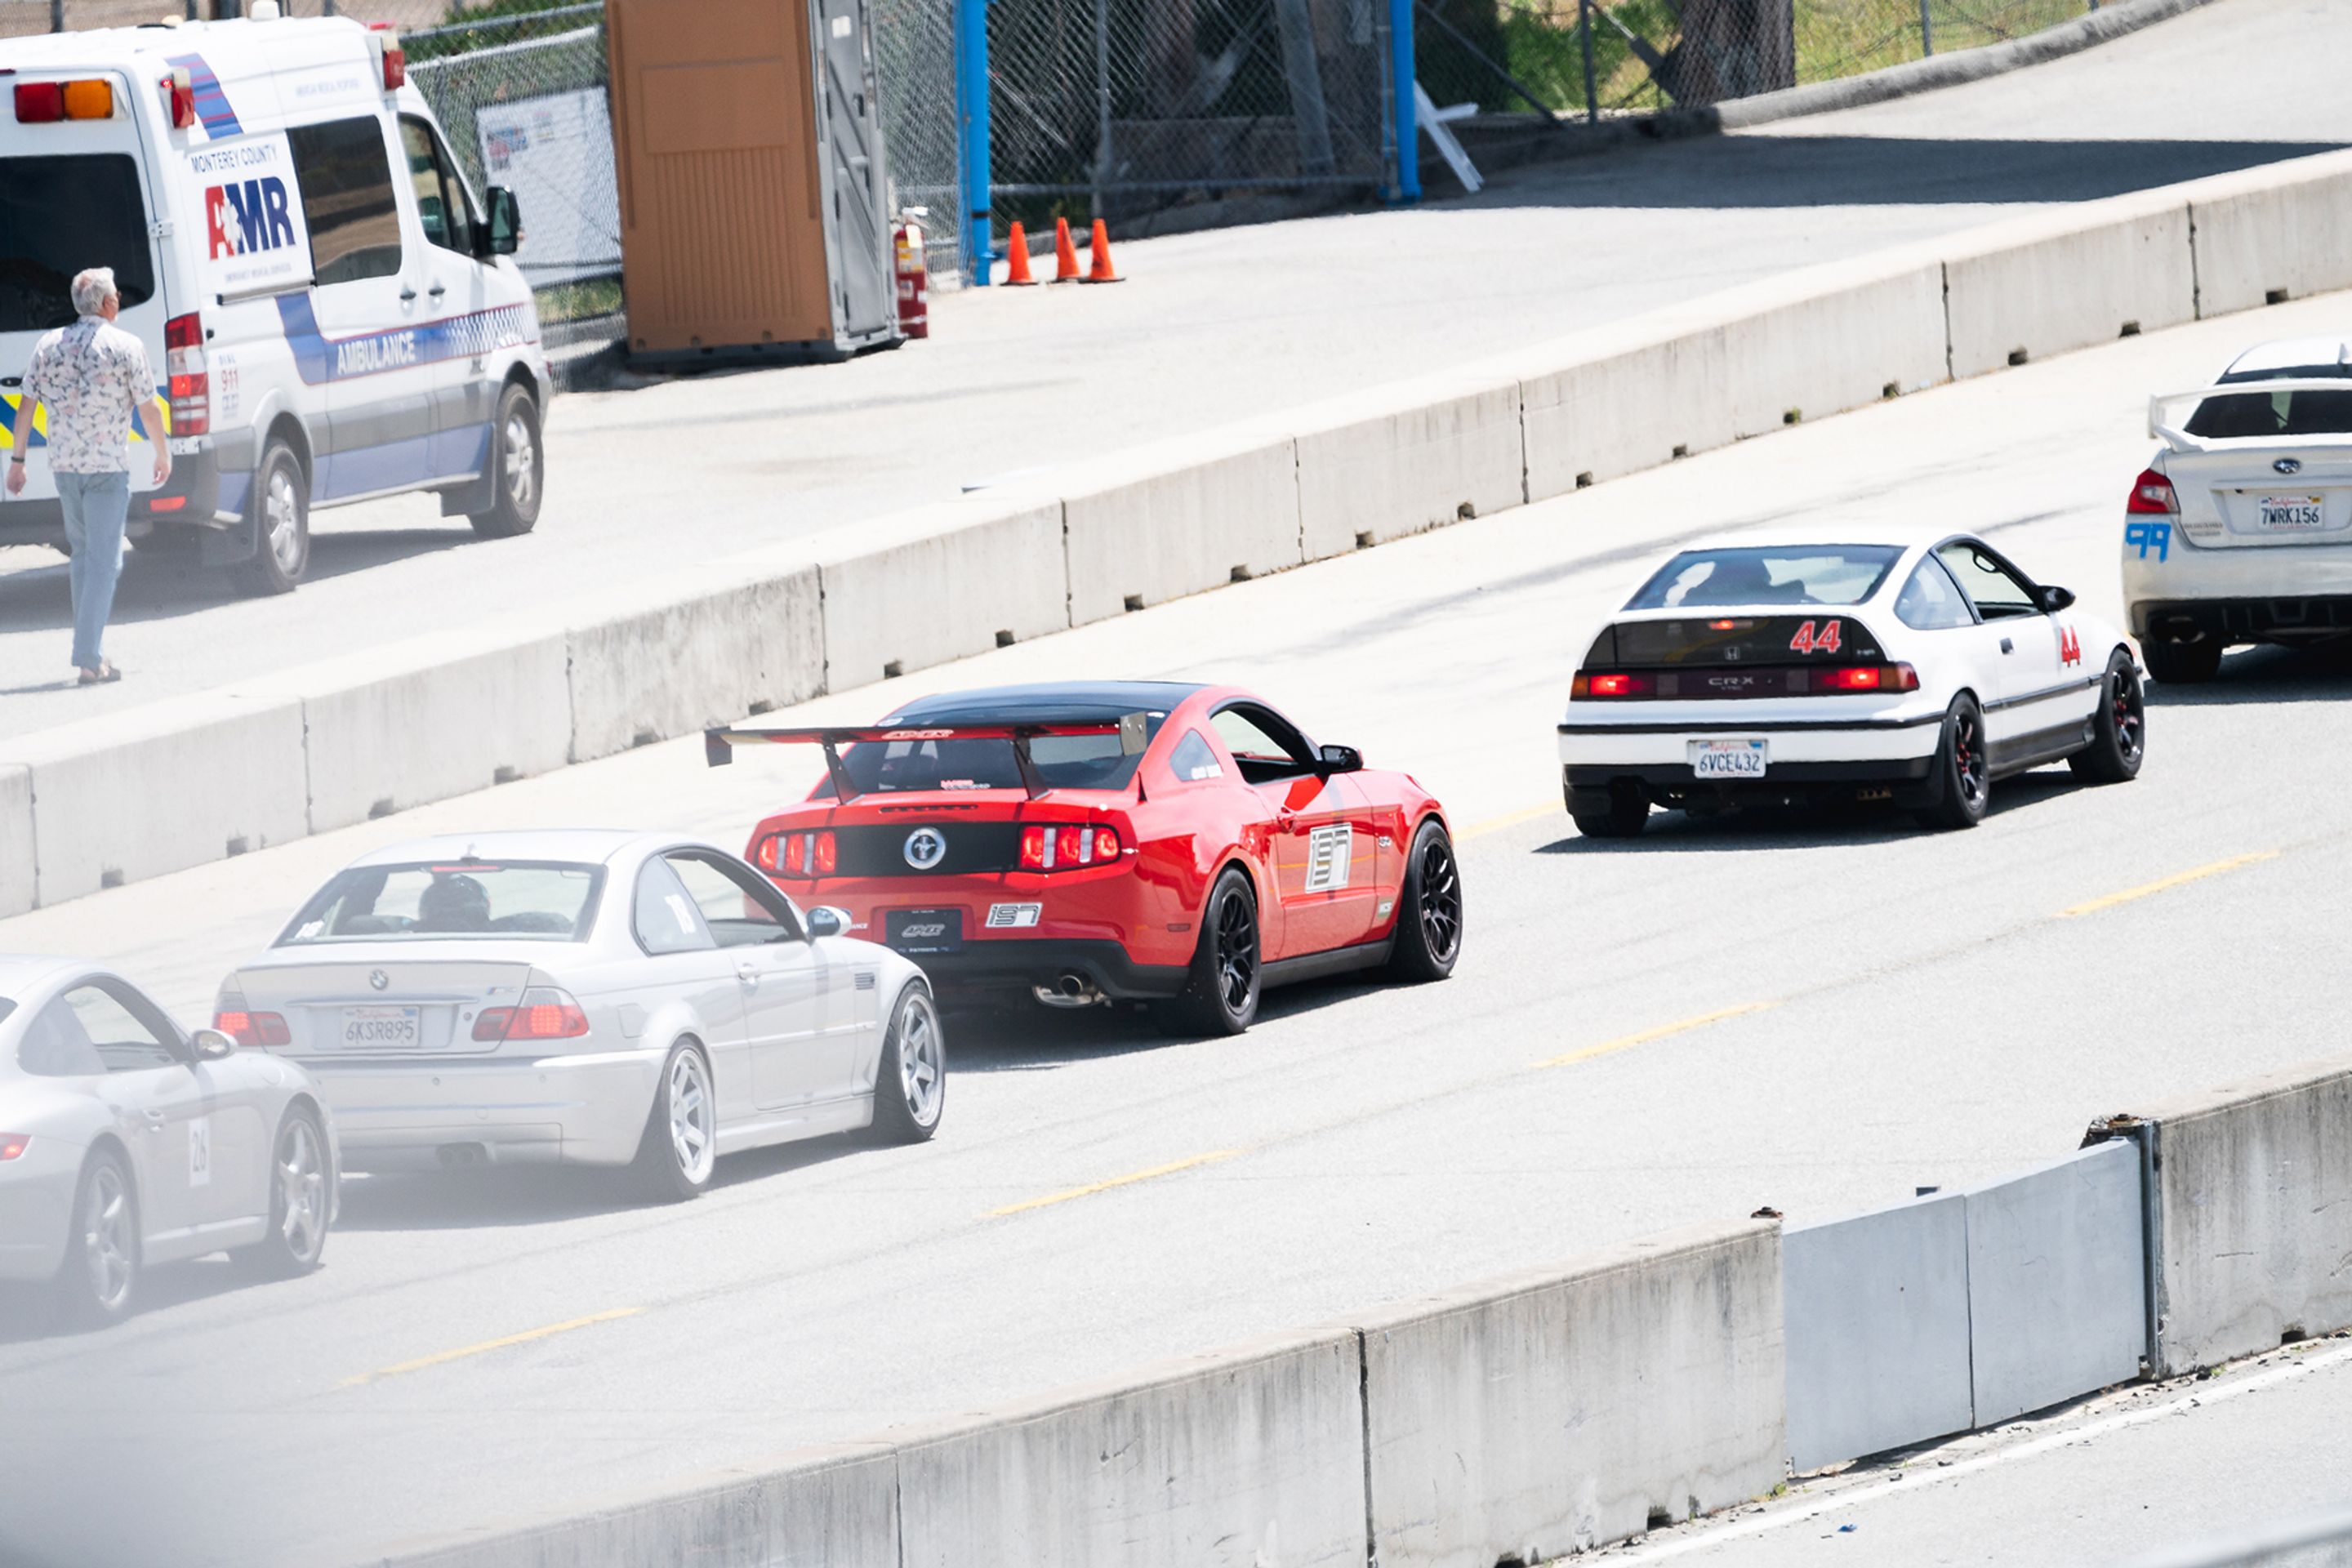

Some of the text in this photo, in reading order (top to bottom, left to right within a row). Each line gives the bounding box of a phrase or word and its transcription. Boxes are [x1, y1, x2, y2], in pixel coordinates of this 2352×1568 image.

[191, 145, 278, 173] MONTEREY COUNTY
[205, 176, 296, 261] AMR
[336, 332, 416, 376] AMBULANCE
[221, 368, 238, 392] 911
[2261, 507, 2319, 525] 7WRK156
[2126, 523, 2172, 564] 99
[1790, 619, 1842, 654] 44
[2060, 626, 2081, 667] 44
[1699, 753, 1760, 773] 6VCE432
[346, 1021, 414, 1040] 6KSR895
[192, 1129, 207, 1172] 26
